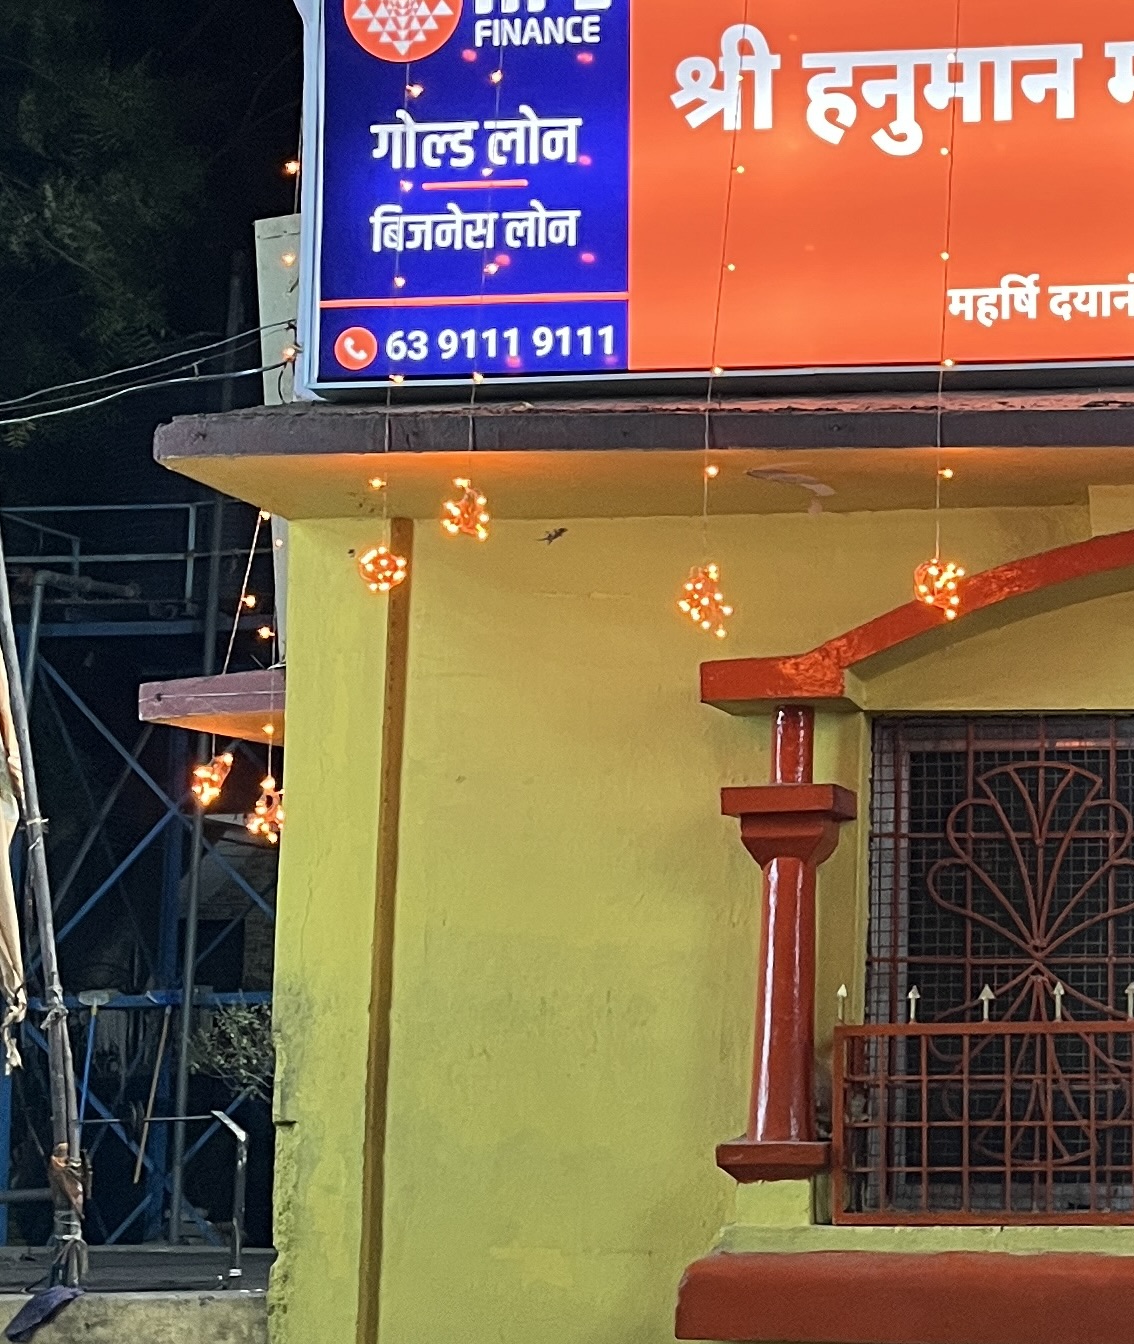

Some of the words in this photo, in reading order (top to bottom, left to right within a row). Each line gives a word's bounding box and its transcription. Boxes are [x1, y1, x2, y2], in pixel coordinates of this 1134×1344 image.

[474, 16, 600, 48] FINANCE
[671, 23, 781, 131] श्री
[802, 42, 1083, 156] हनुमान
[369, 109, 480, 169] गोल्ड
[483, 104, 583, 166] लोन
[369, 203, 499, 252] बिजनेस
[502, 199, 582, 248] लोन
[948, 273, 1041, 327] महर्षि
[386, 331, 428, 361] 63
[437, 327, 519, 359] 9111
[532, 325, 614, 356] 9111
